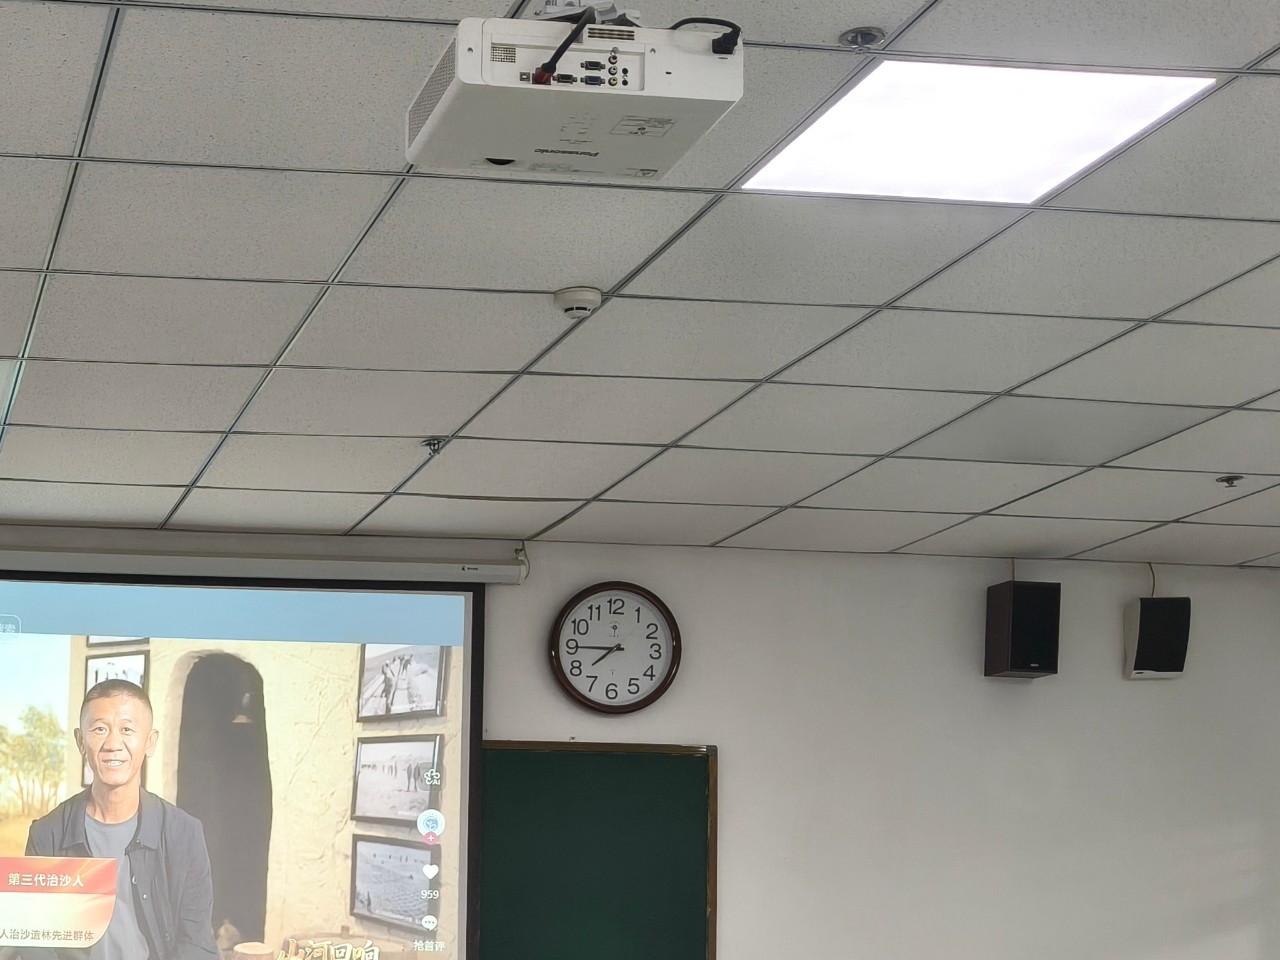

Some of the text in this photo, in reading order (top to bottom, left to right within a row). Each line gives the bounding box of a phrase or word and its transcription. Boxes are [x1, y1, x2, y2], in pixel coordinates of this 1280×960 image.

[535, 148, 600, 157] Panasonic
[587, 604, 601, 621] 11
[607, 598, 625, 615] 12
[635, 606, 641, 623] 1
[571, 618, 589, 635] 10
[645, 623, 659, 640] 2
[566, 638, 579, 655] 9
[649, 643, 662, 660] 3
[569, 660, 582, 677] 8
[642, 665, 656, 681] 4
[586, 675, 598, 692] 7
[605, 683, 618, 700] 6
[627, 678, 640, 695] 5
[8, 872, 85, 888] 第三代治沙人
[420, 889, 440, 900] 959
[413, 940, 446, 952] 抢首评
